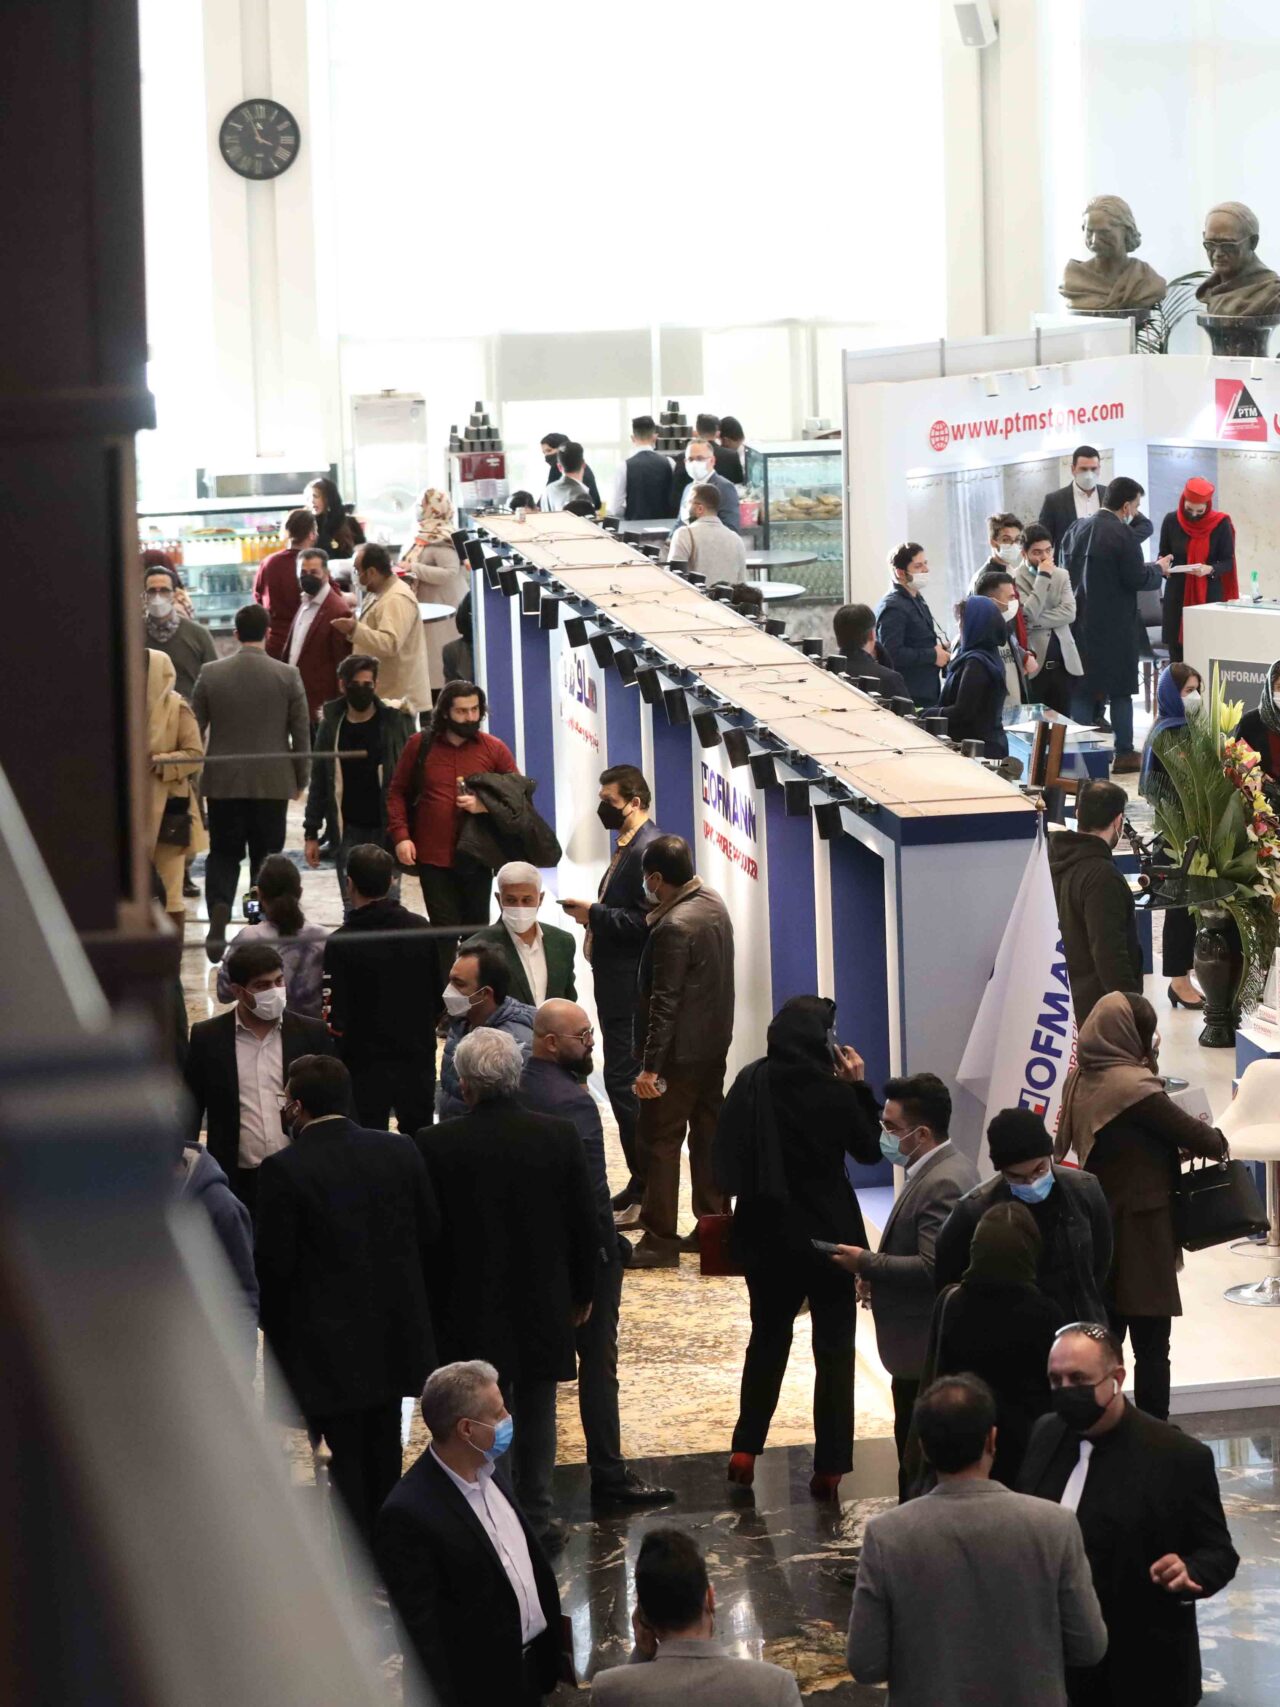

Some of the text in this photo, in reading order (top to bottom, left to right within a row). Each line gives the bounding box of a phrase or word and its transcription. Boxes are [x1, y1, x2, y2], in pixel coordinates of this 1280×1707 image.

[951, 401, 1125, 442] www.ptmstone.com
[1237, 406, 1259, 418] PTM
[1220, 670, 1268, 685] INFORMA
[1017, 936, 1071, 1124] HOFMA
